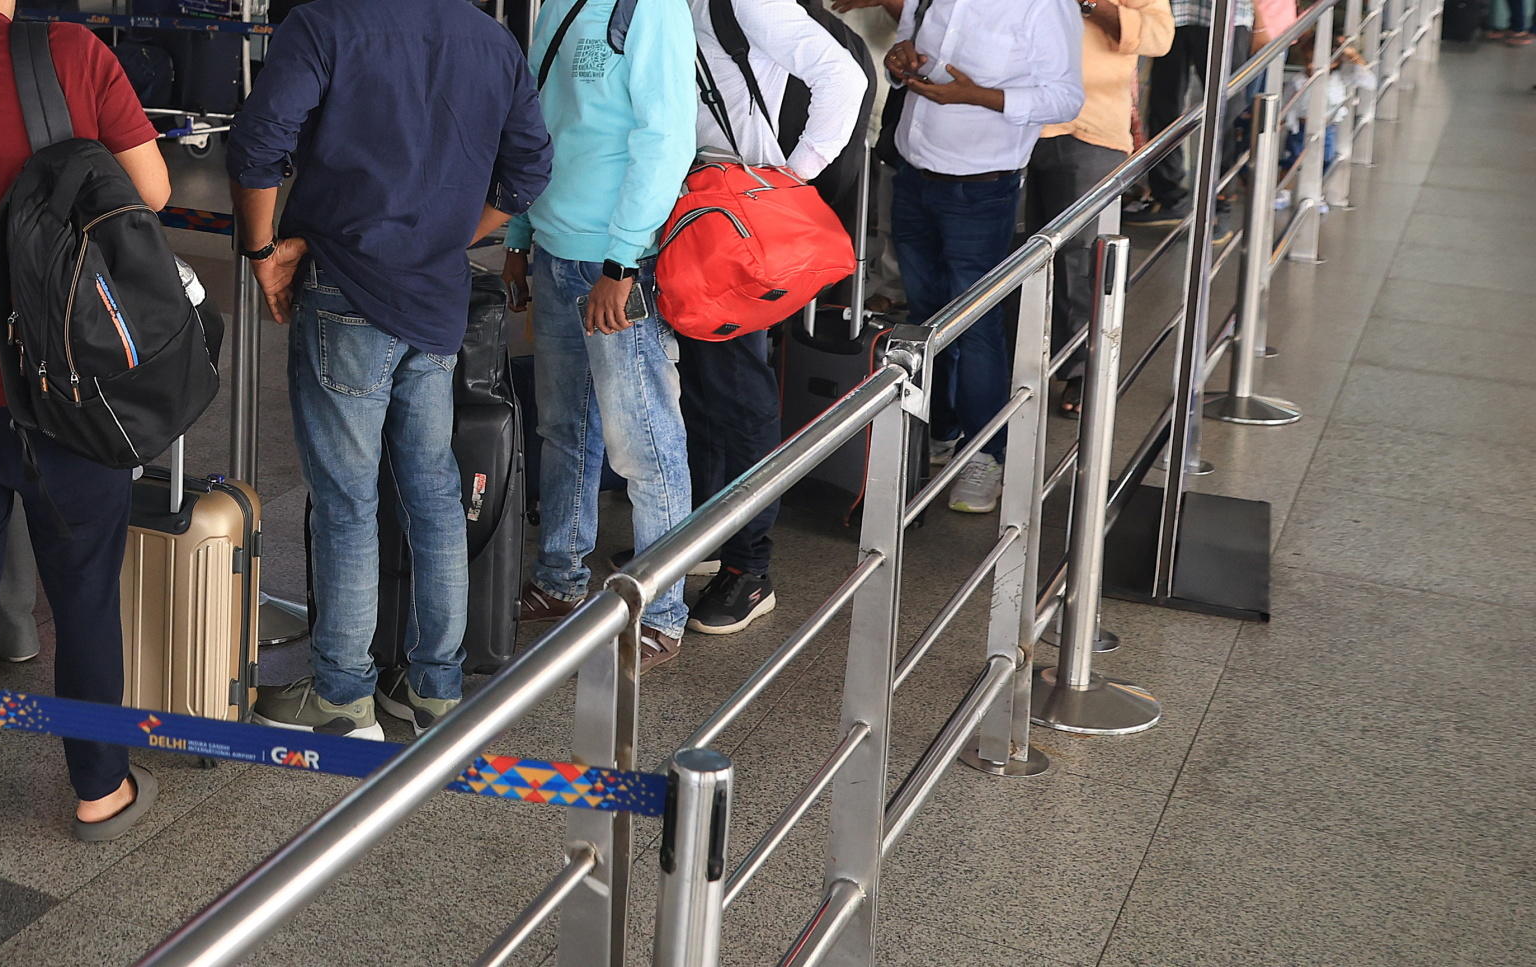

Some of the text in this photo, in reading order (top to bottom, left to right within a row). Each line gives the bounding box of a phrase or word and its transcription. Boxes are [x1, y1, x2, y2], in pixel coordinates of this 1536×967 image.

[148, 734, 187, 751] DELHI
[232, 751, 256, 761] AIRPORT
[271, 746, 319, 770] GMR
